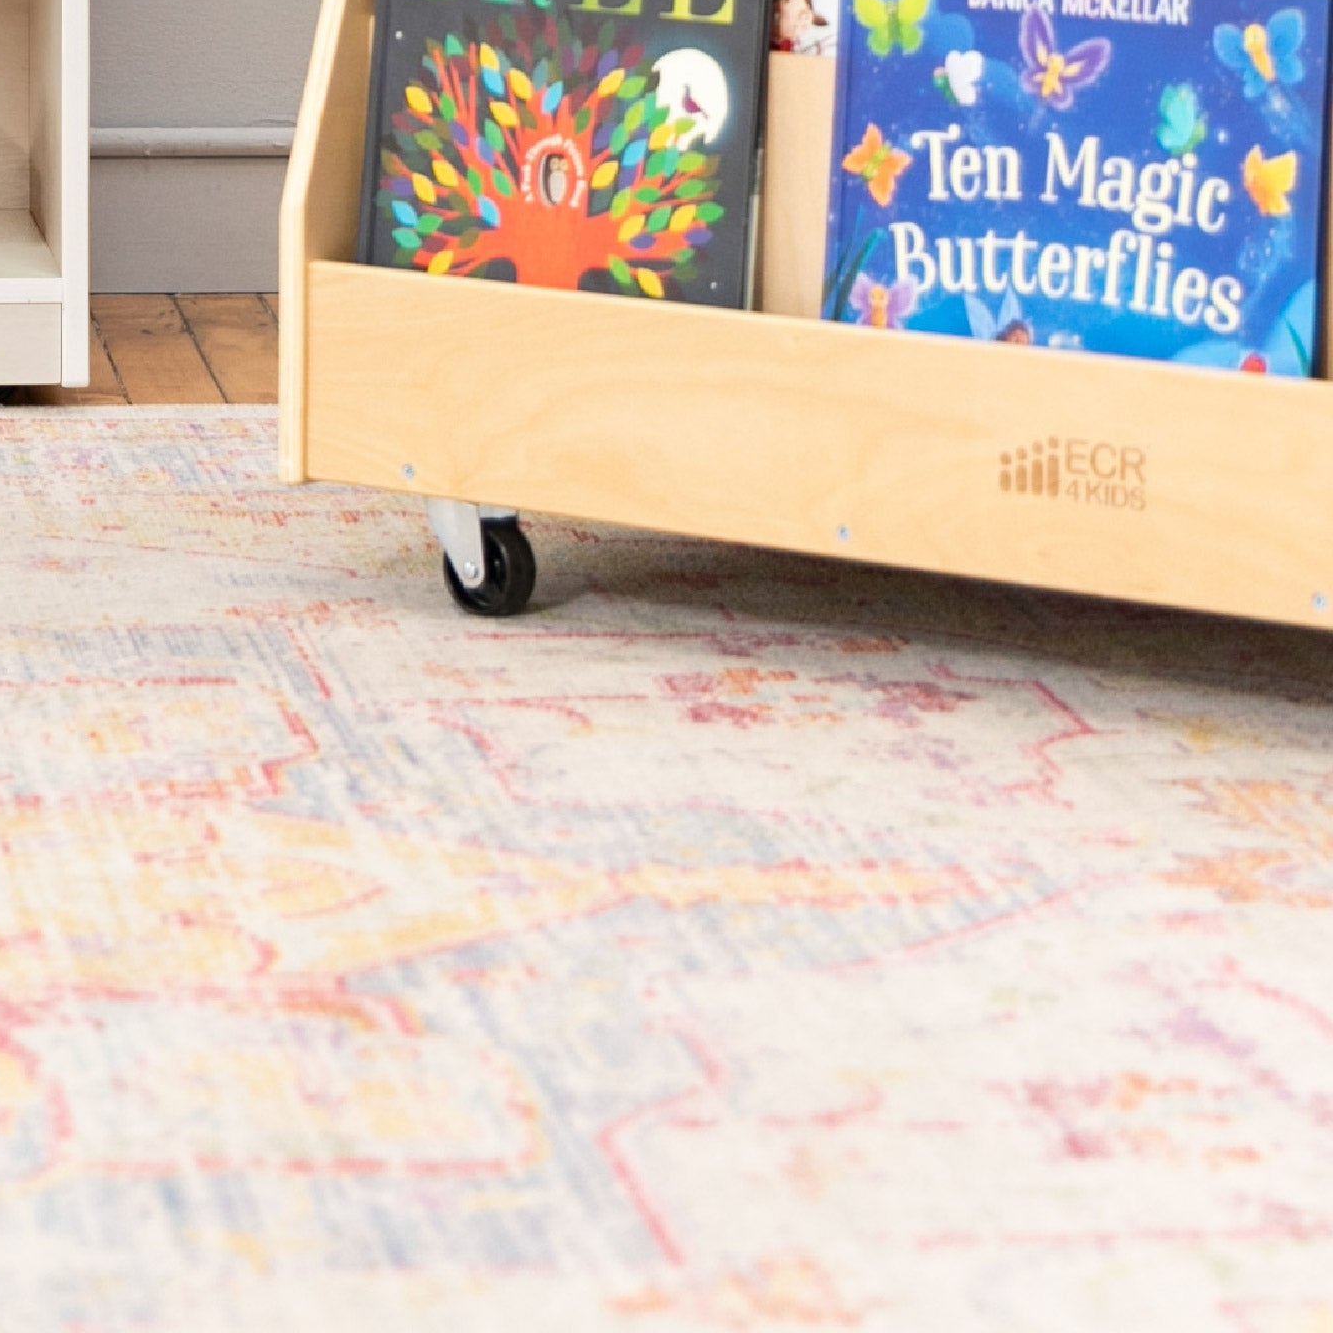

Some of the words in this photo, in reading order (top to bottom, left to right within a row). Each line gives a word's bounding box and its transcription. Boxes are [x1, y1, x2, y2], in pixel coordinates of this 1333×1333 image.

[910, 124, 1022, 201] Ten
[1040, 132, 1230, 233] Magic
[889, 222, 1242, 332] Butterflies
[1064, 438, 1147, 484] ECR
